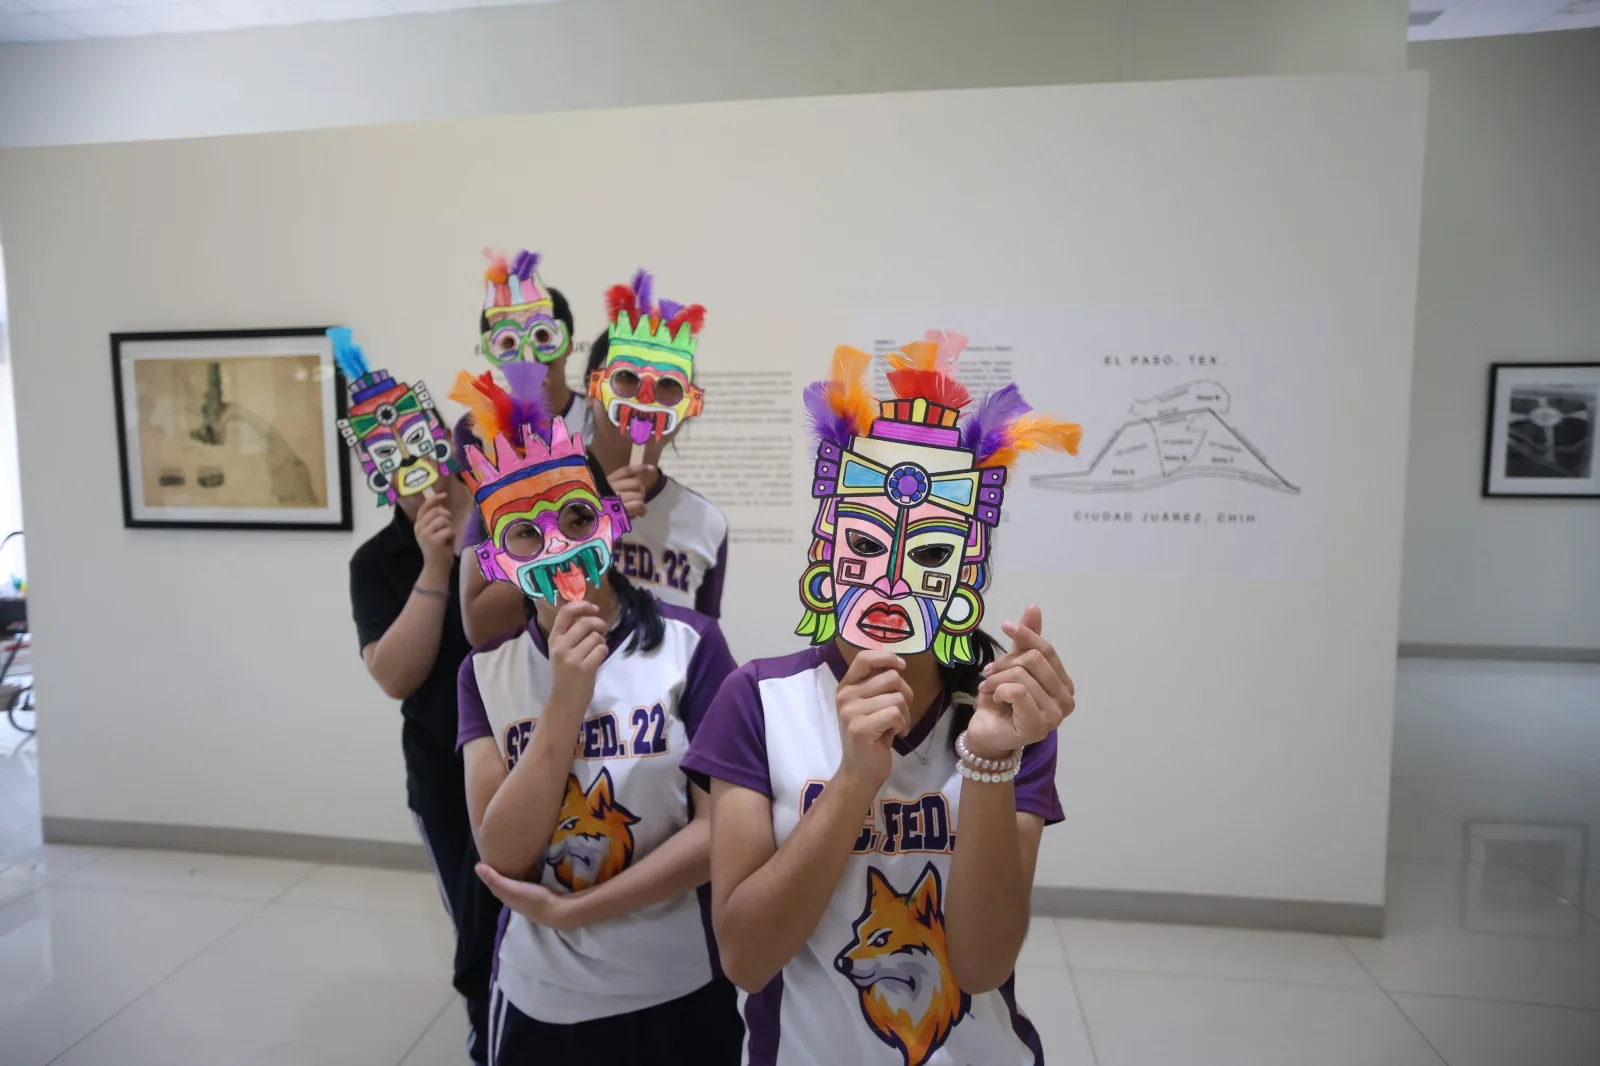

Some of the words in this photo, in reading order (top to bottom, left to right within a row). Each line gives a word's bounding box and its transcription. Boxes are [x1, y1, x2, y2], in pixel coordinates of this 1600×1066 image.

[1103, 354, 1121, 366] EL
[1073, 511, 1133, 523] CIUDAD
[662, 548, 690, 593] 22
[630, 700, 668, 757] 22
